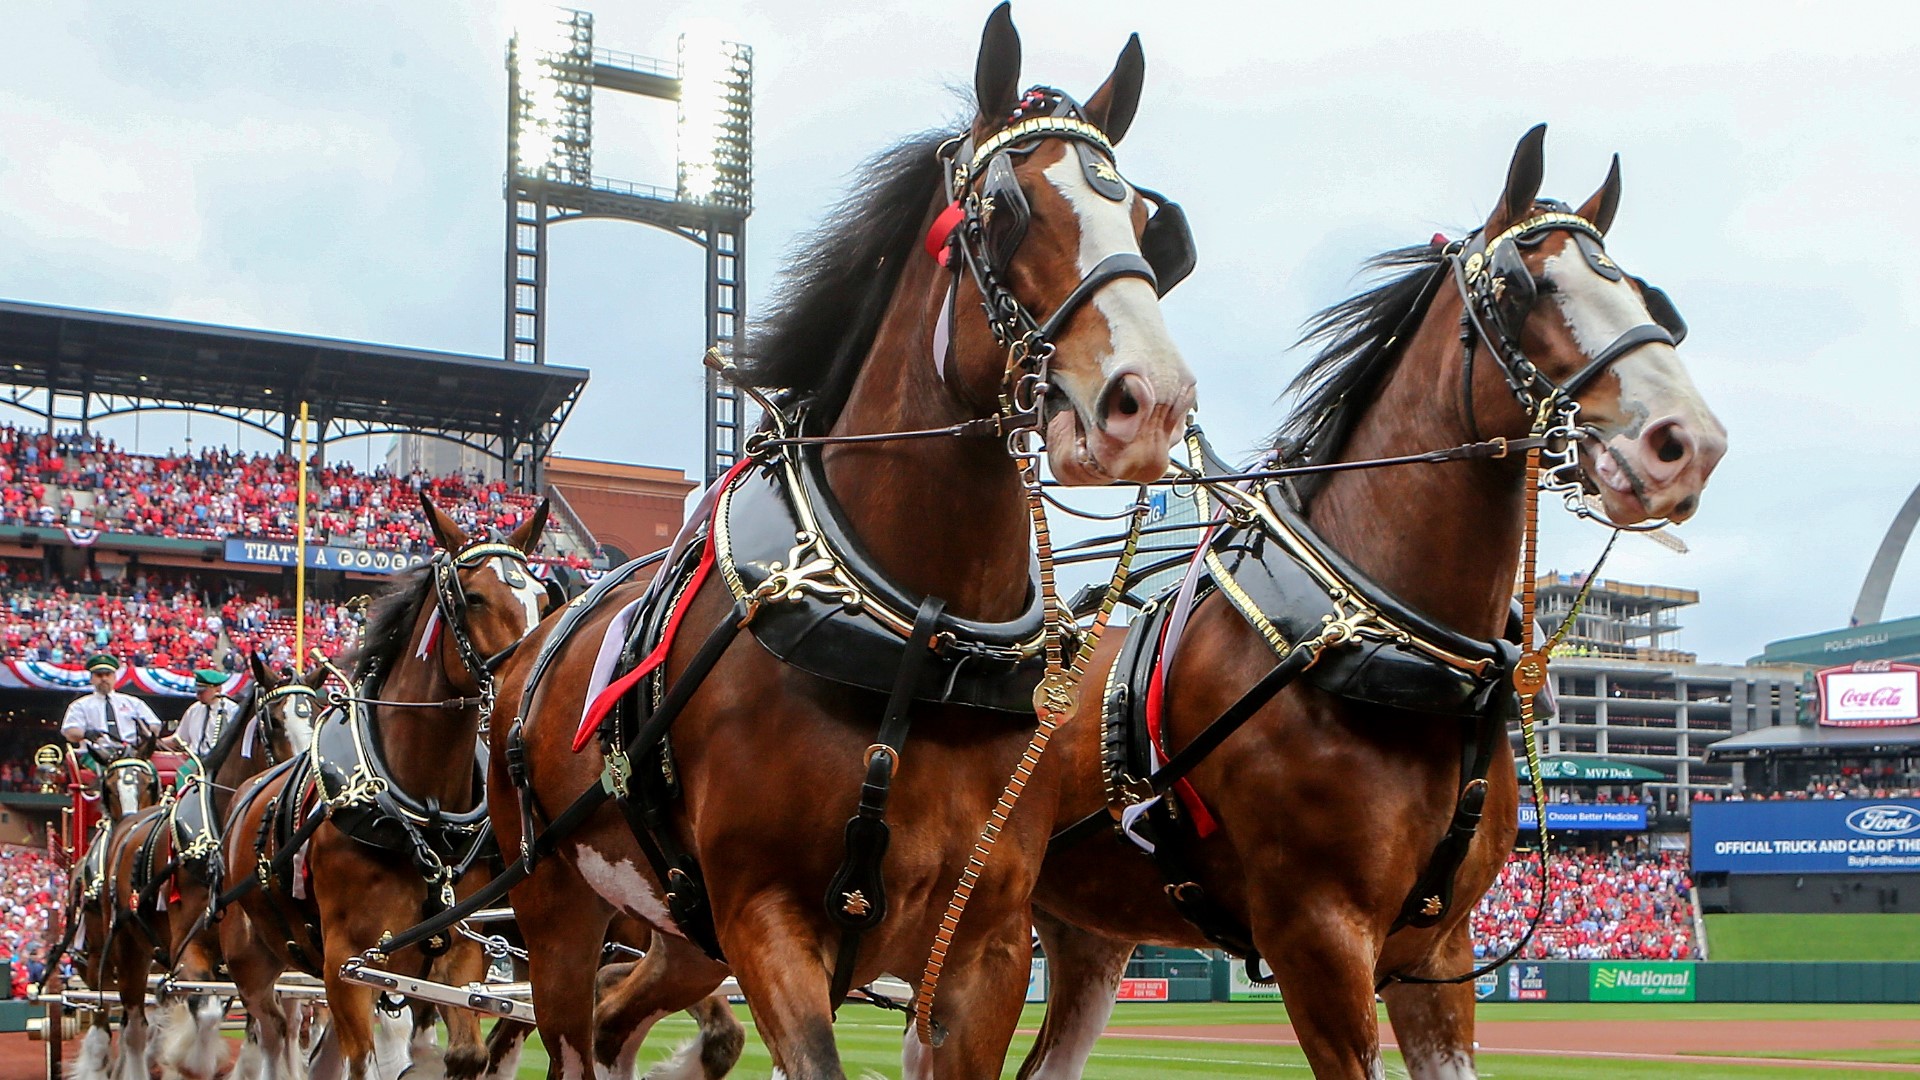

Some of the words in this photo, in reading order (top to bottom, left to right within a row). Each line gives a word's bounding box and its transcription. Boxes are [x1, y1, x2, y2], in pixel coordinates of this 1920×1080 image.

[315, 549, 327, 565] A
[1823, 632, 1889, 653] POLSINELLI
[1585, 767, 1609, 779] MVP
[1610, 767, 1633, 779] Deck
[1549, 812, 1577, 821] Choose
[1579, 812, 1603, 821] Better
[1604, 812, 1639, 821] Medicine
[1860, 809, 1913, 830] Ford
[1715, 841, 1772, 854] OFFICIAL
[1774, 840, 1817, 854] TRUCK
[1819, 840, 1847, 853] AND
[1849, 839, 1875, 853] CAR
[1876, 839, 1896, 852] OF
[1616, 970, 1690, 986] National
[1642, 987, 1656, 995] Car
[1658, 987, 1686, 995] Rental
